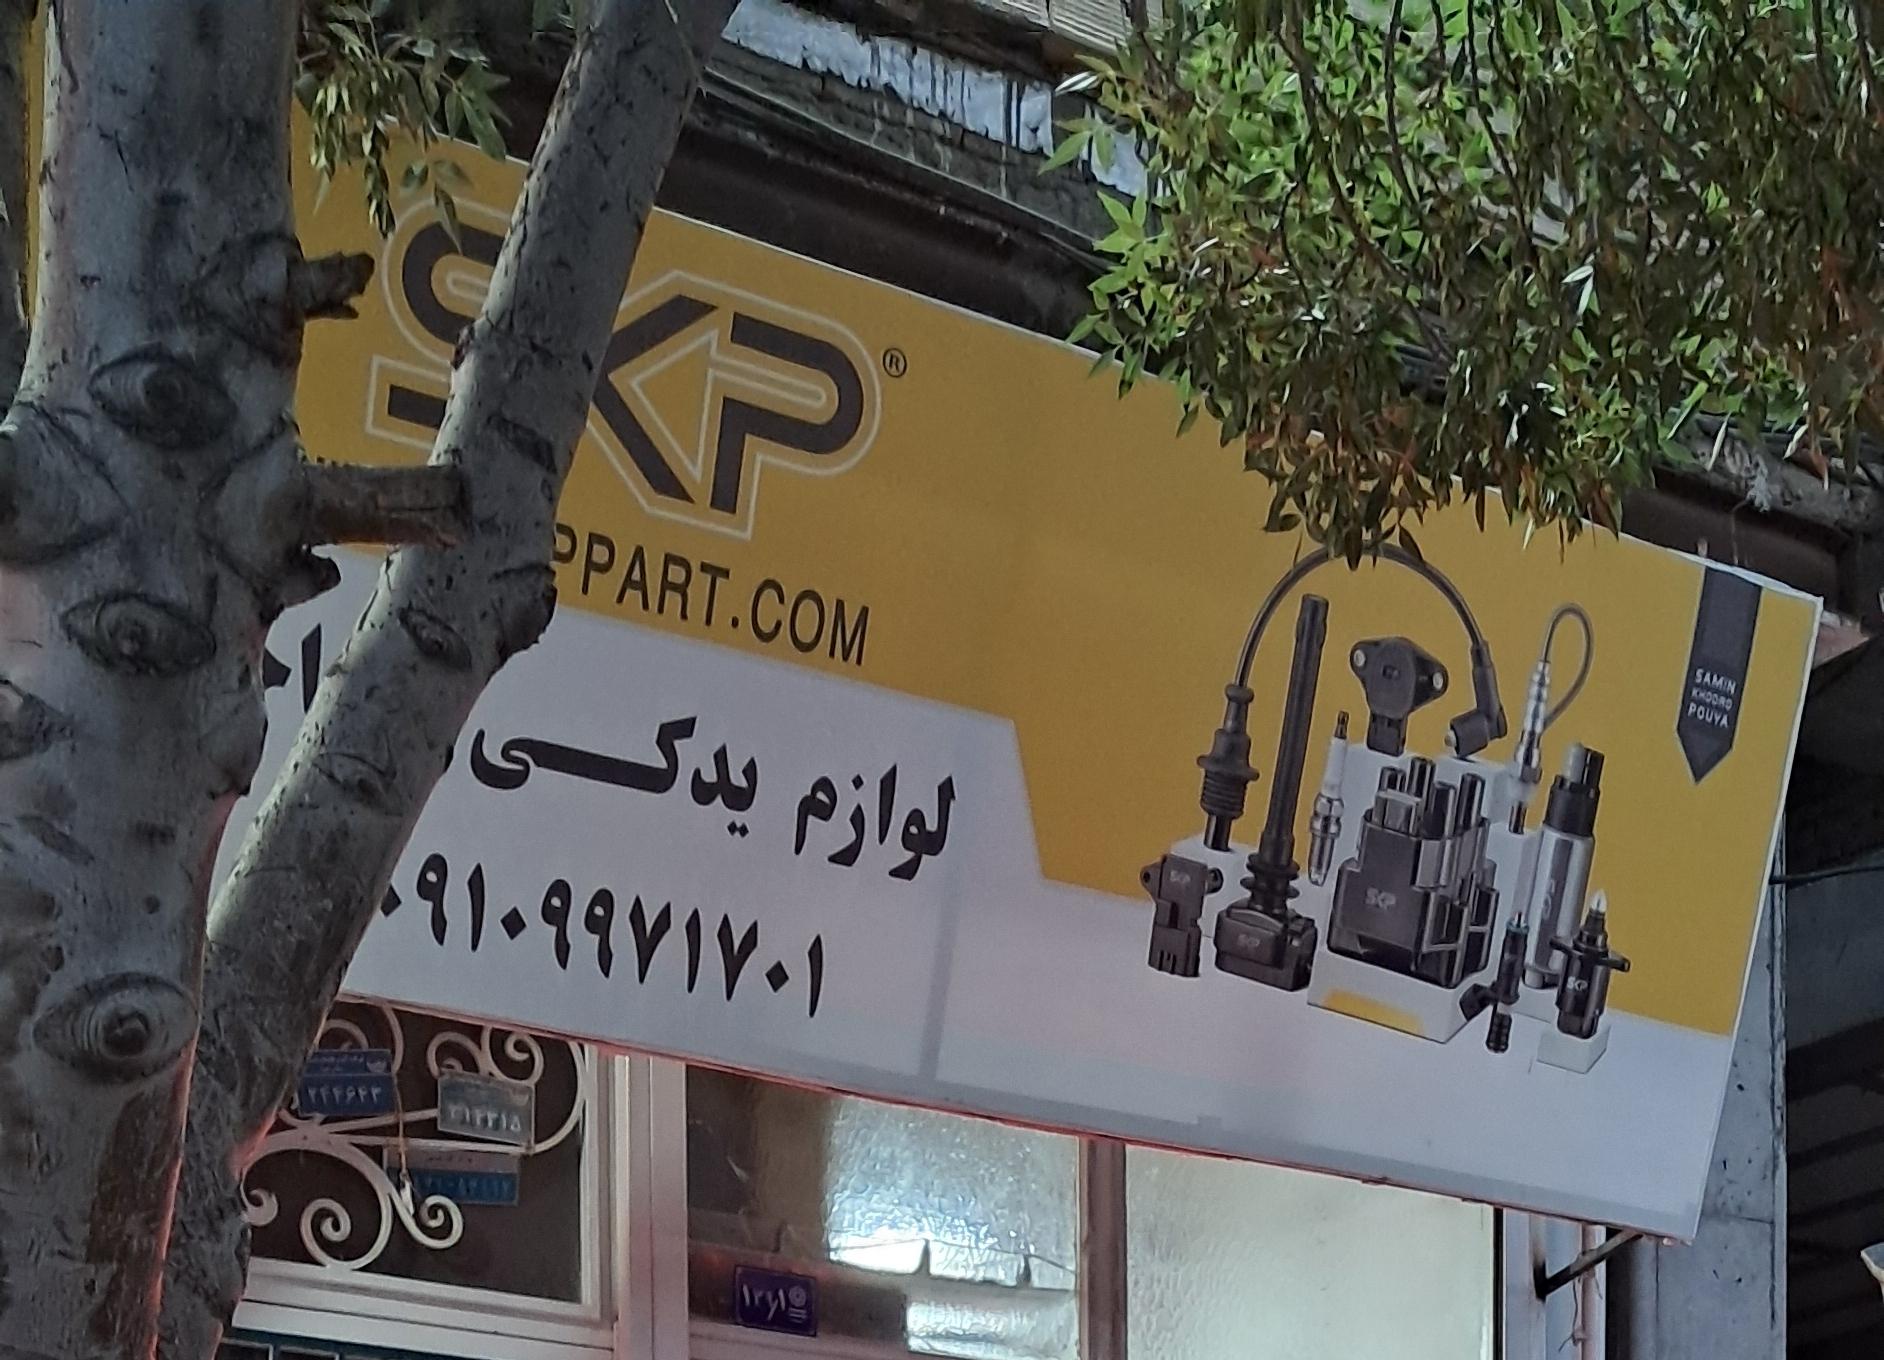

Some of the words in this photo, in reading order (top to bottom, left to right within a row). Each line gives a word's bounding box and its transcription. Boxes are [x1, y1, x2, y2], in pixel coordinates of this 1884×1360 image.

[1688, 702, 1728, 728] POUYA
[1695, 668, 1736, 695] SAMIN
[470, 716, 757, 837] یدکی
[795, 763, 955, 881] لوازم
